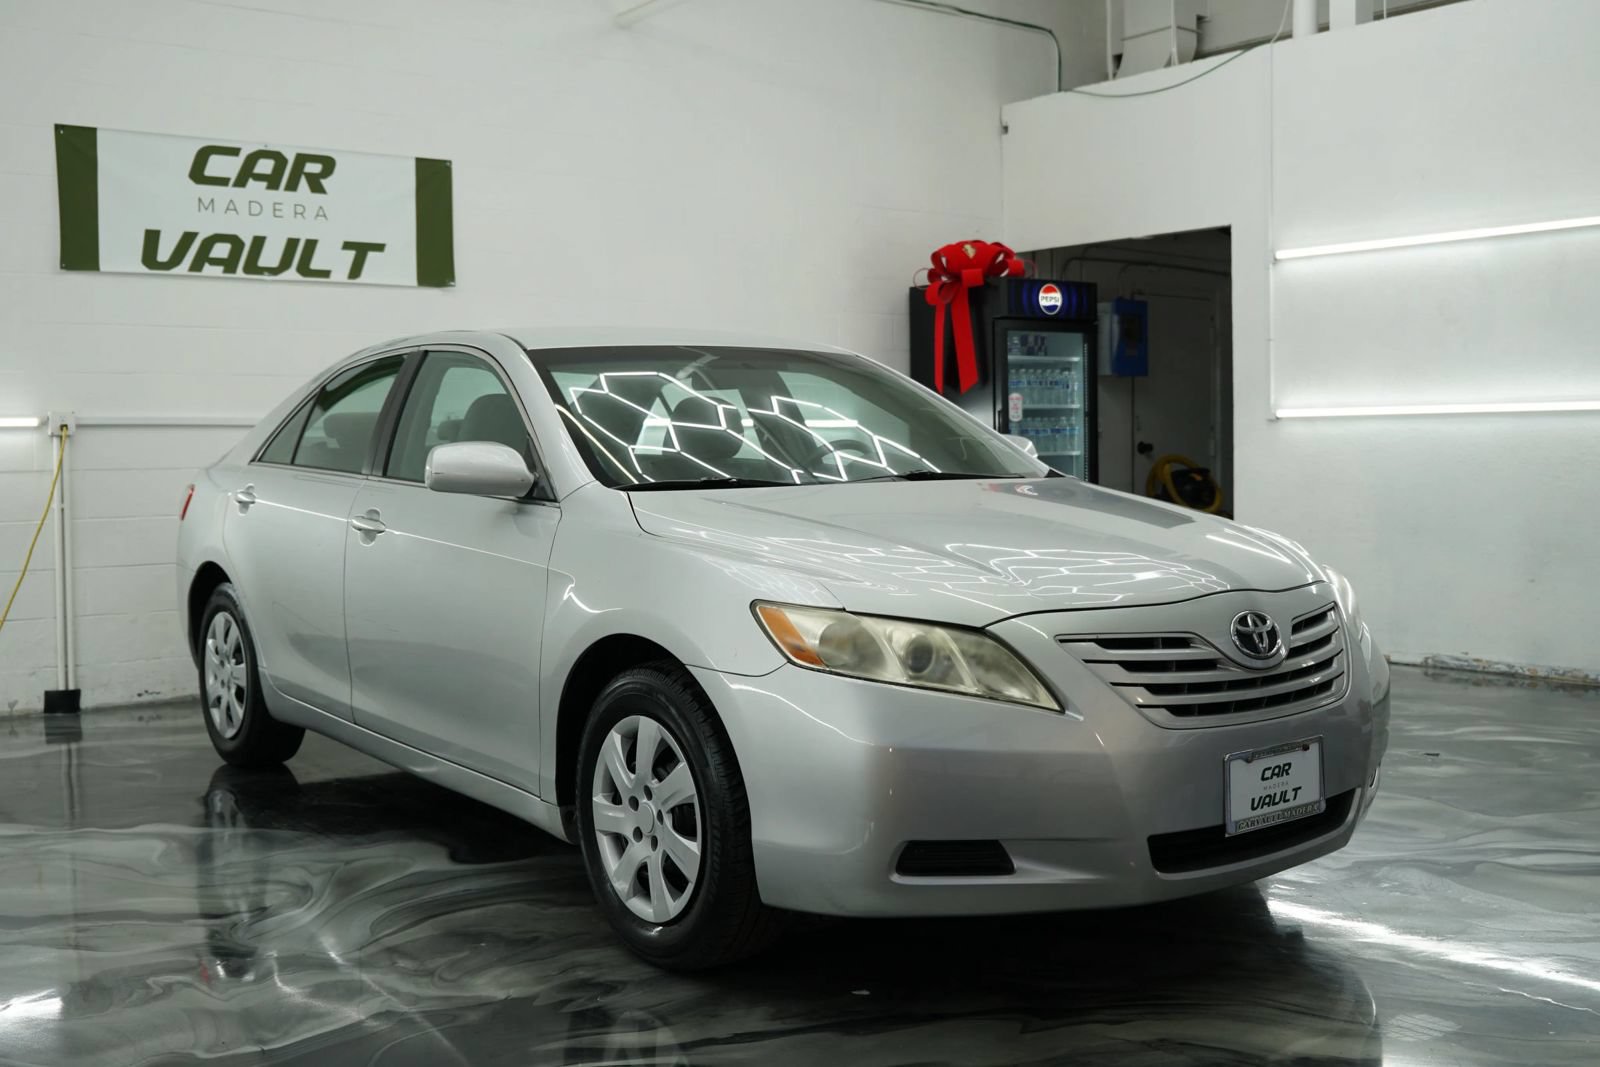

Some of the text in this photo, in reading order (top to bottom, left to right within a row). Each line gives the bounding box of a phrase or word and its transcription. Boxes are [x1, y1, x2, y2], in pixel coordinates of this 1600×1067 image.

[188, 145, 337, 195] CAR
[197, 197, 329, 221] MADERA
[141, 229, 387, 280] VAULT
[1041, 295, 1060, 303] PEPSI
[1261, 762, 1292, 781] CAR
[1250, 786, 1302, 811] VAULT
